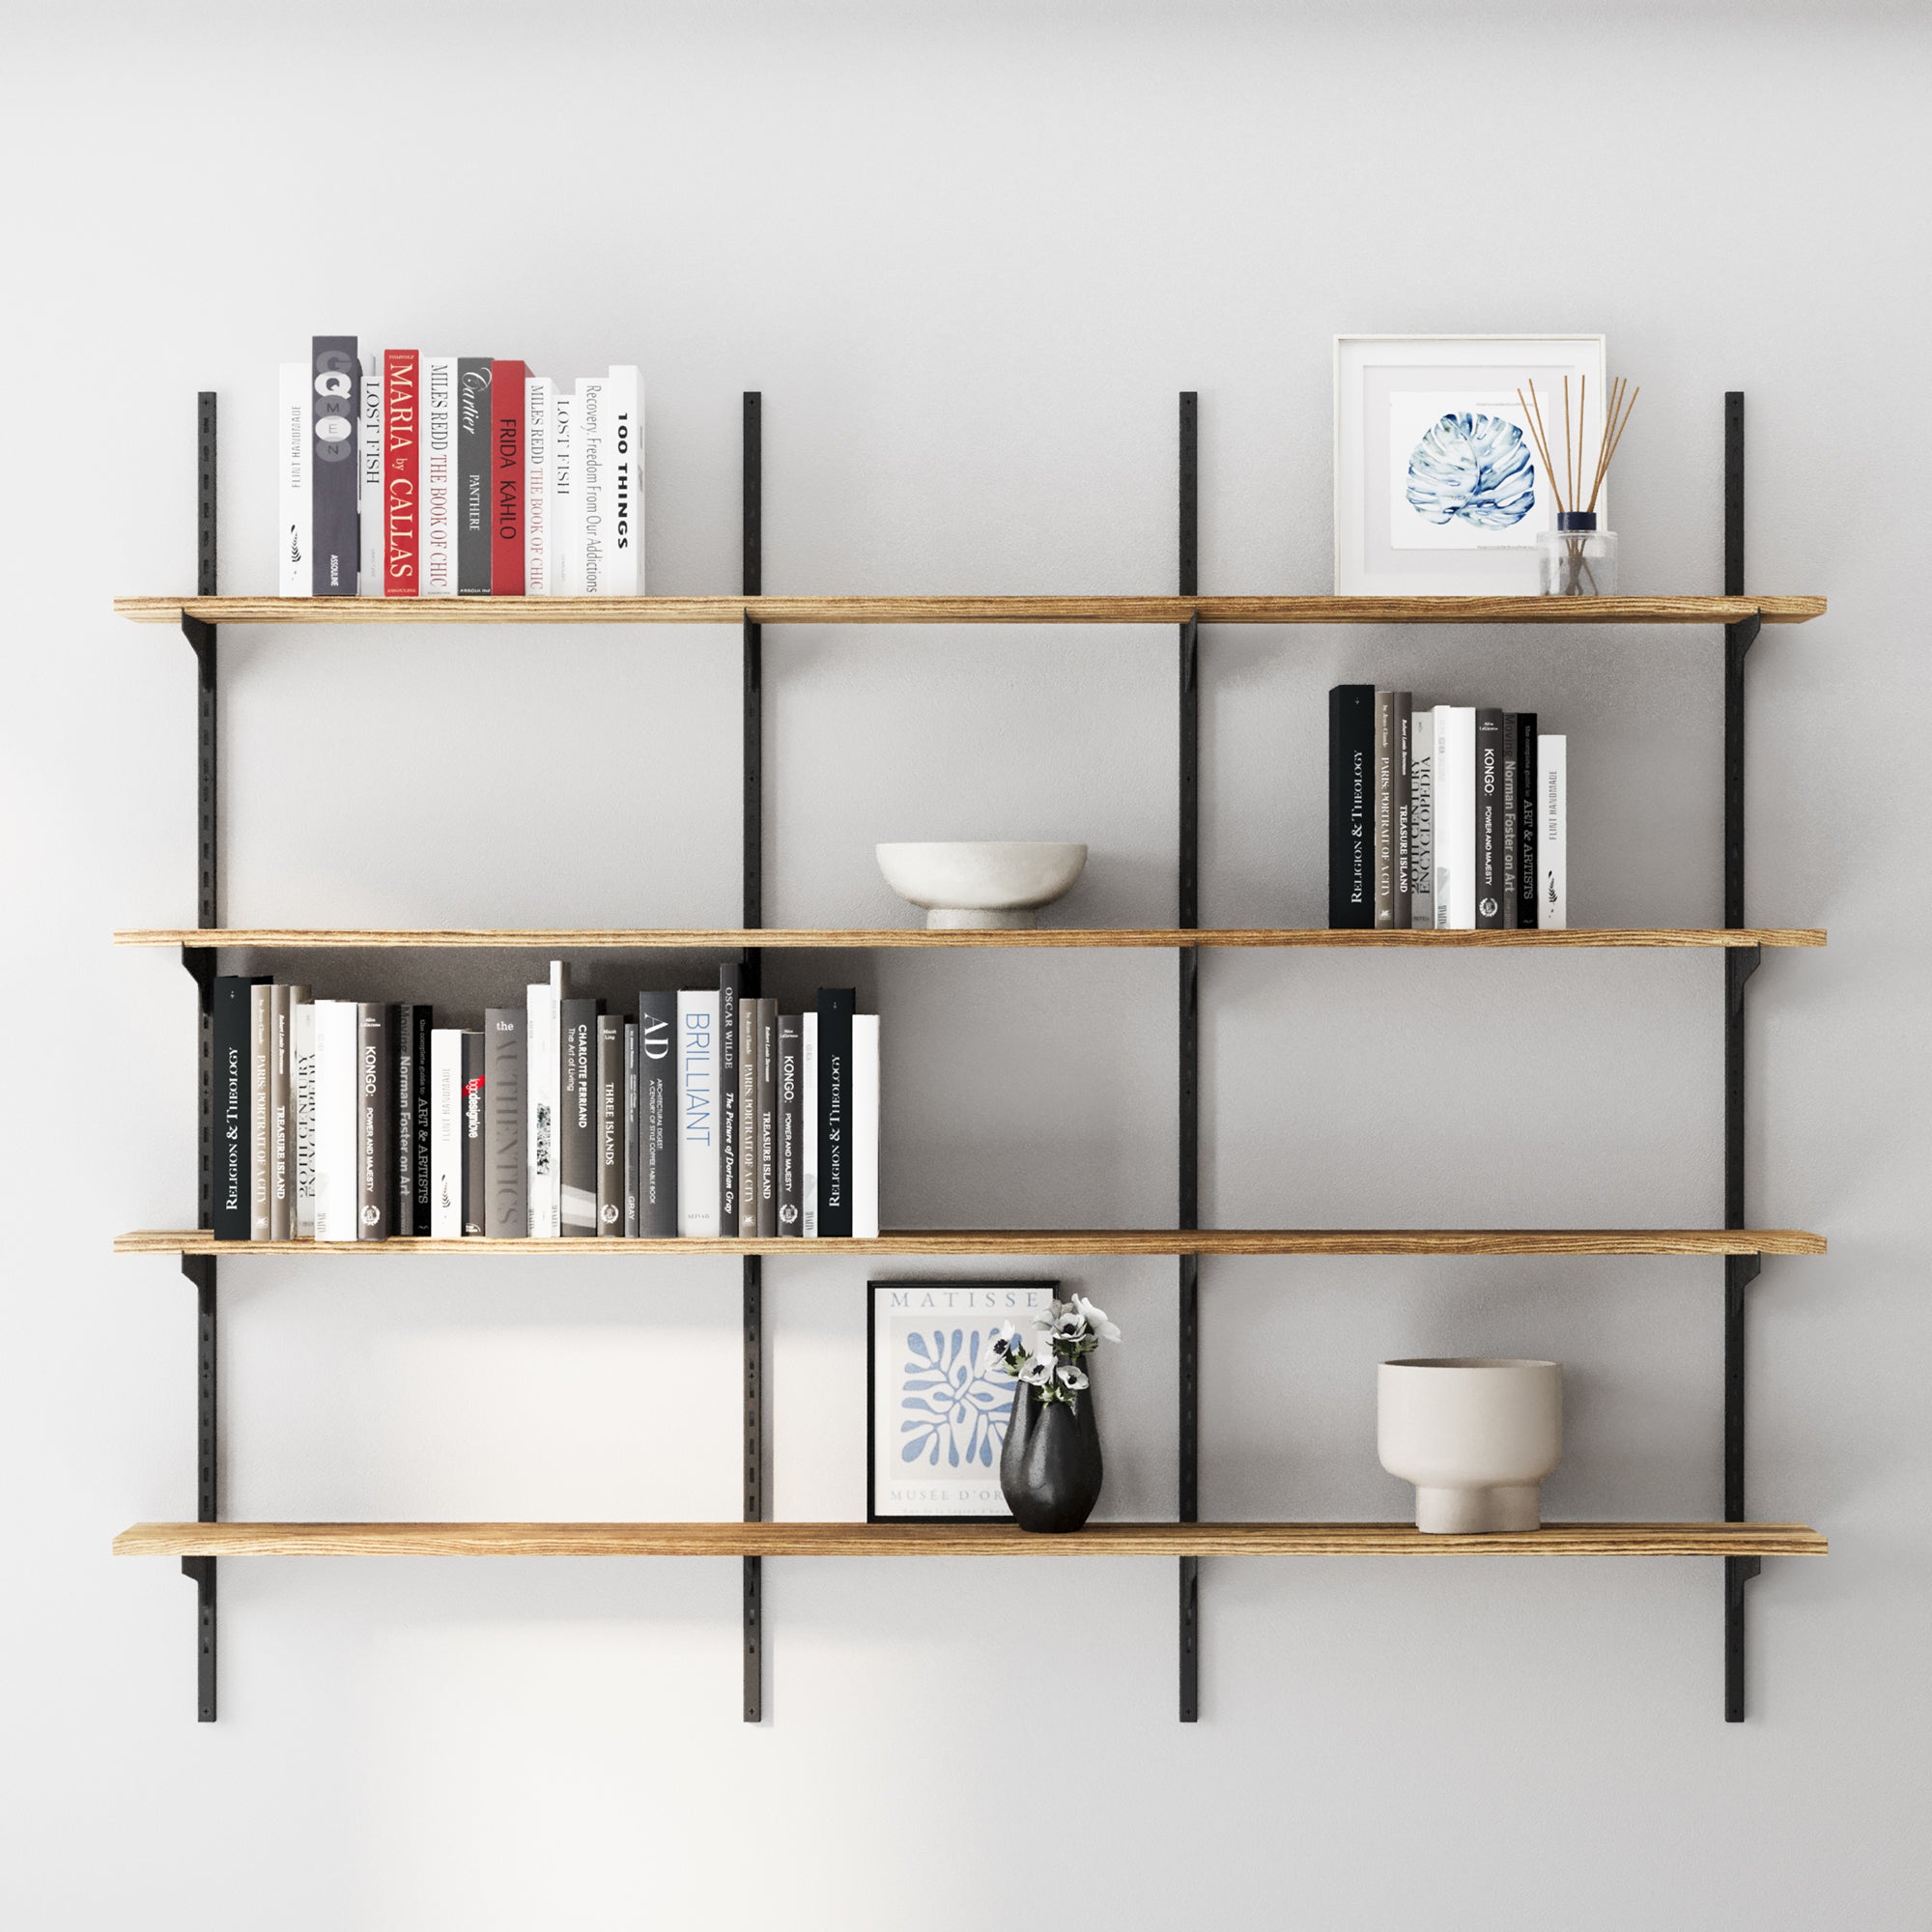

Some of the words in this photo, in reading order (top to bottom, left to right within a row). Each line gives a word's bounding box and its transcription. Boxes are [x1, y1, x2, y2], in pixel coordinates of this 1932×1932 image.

[431, 365, 448, 408] MILES
[462, 367, 492, 435] Cartier
[530, 385, 544, 425] MILES
[367, 383, 380, 435] LOST
[390, 364, 413, 450] MARIA
[557, 400, 569, 449] LOST
[292, 405, 301, 458] HANDMADE
[431, 412, 448, 450] REDD
[500, 418, 517, 469] FRIDA
[530, 429, 544, 465] REDD
[618, 412, 629, 454] 100
[291, 464, 300, 488] FLINT
[367, 440, 380, 484] FISH
[392, 457, 408, 470] by
[431, 454, 447, 483] THE
[530, 468, 544, 494] THE
[557, 453, 569, 495] FISH
[586, 439, 602, 483] Freedom
[431, 488, 447, 526] BOOK
[469, 474, 479, 530] PANTHERE
[499, 480, 517, 540] KAHLO
[530, 497, 544, 533] BOOK
[586, 486, 602, 512] From
[617, 463, 629, 549] THINGS
[390, 479, 413, 578] CALLAS
[430, 529, 447, 550] OF
[530, 536, 544, 555] OF
[586, 515, 602, 536] Our
[430, 554, 447, 586] CHIC
[531, 558, 543, 589] CHIC
[586, 539, 602, 593] Addictions
[1351, 750, 1363, 818] THEOLOGY
[1484, 749, 1494, 796] KONGO:
[1504, 761, 1517, 810] Norman
[1351, 821, 1363, 838] &
[1380, 793, 1389, 845] PORTRAIT
[1421, 756, 1431, 894] ENCYCLOPEDIA
[1504, 813, 1517, 850] Foster
[1524, 800, 1533, 826] ART
[1548, 816, 1557, 840] FLINT
[1380, 848, 1389, 862] OF
[1524, 829, 1533, 842] &
[1351, 841, 1362, 903] RELIGION
[1504, 853, 1514, 869] on
[1524, 844, 1533, 900] ARTISTS
[1380, 873, 1389, 896] CITY
[1504, 871, 1516, 893] Art
[497, 1021, 514, 1031] the
[644, 1012, 669, 1060] AD
[568, 1057, 576, 1066] of
[579, 1025, 587, 1077] CHARLOTTE
[226, 1047, 238, 1121] THEOLOGY
[366, 1046, 377, 1097] KONGO:
[400, 1056, 412, 1108] Norman
[567, 1068, 576, 1092] Living
[685, 1013, 710, 1146] BRILLIANT
[784, 1055, 794, 1103] KONGO:
[829, 1055, 840, 1123] THEOLOGY
[299, 1055, 308, 1139] CENTURY
[419, 1097, 428, 1125] ART
[579, 1081, 587, 1128] PERRIAND
[606, 1083, 614, 1118] THREE
[226, 1124, 238, 1141] &
[257, 1093, 267, 1148] PORTRAIT
[400, 1111, 412, 1152] Foster
[419, 1129, 428, 1143] &
[497, 1040, 519, 1224] AUTHENTICS
[649, 1115, 655, 1124] OF
[744, 1099, 753, 1151] PORTRAIT
[829, 1126, 840, 1143] &
[257, 1150, 267, 1164] OF
[605, 1122, 614, 1165] ISLANDS
[725, 1146, 733, 1156] of
[744, 1153, 753, 1167] OF
[226, 1144, 238, 1210] RELIGION
[299, 1145, 308, 1198] 20TH
[400, 1155, 408, 1173] on
[419, 1145, 428, 1204] ARTISTS
[829, 1146, 839, 1208] RELIGION
[257, 1178, 267, 1203] CITY
[400, 1175, 411, 1196] Art
[724, 1192, 733, 1213] Gray
[744, 1179, 753, 1203] CITY
[891, 1293, 1037, 1307] MATISSE
[891, 1489, 949, 1501] MUSÉE
[959, 1491, 1002, 1501] D'OR
